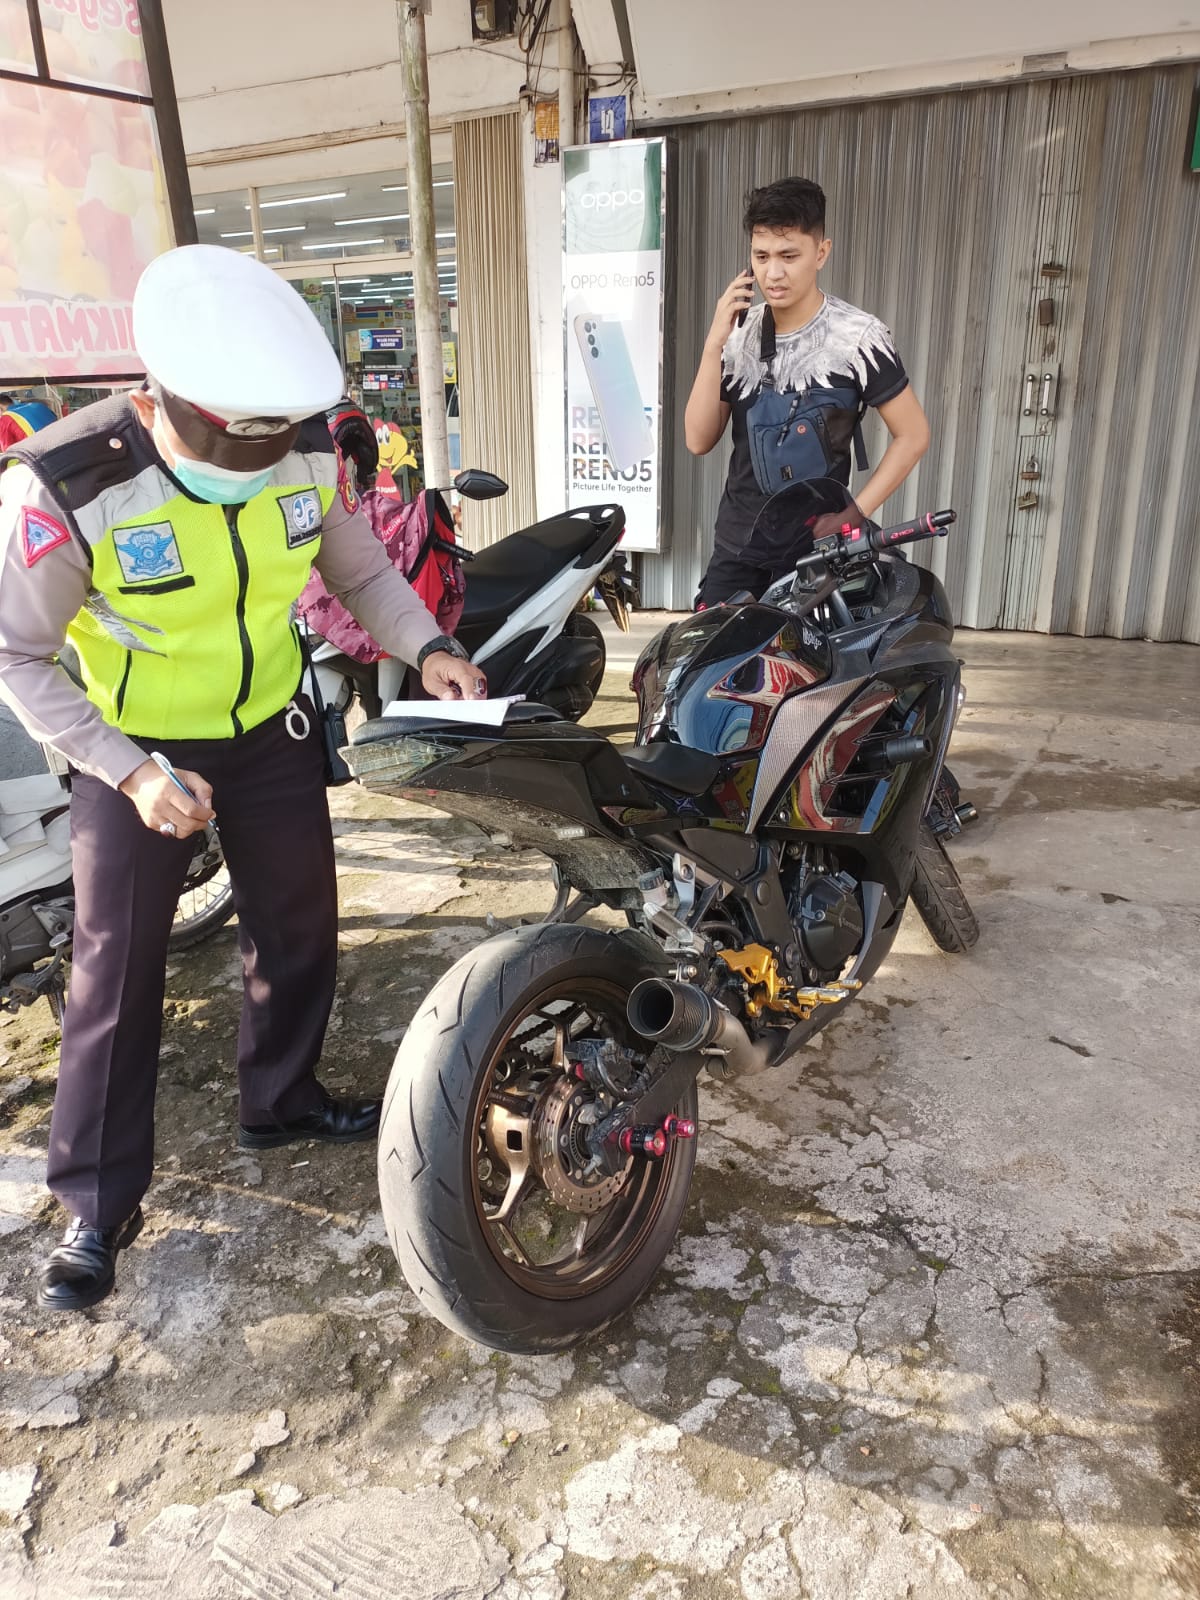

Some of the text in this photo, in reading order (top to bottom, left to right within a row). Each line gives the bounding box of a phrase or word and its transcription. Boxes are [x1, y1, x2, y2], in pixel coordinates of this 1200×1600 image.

[570, 270, 656, 290] OPPO Reno5
[572, 482, 652, 494] Picture Life Together
